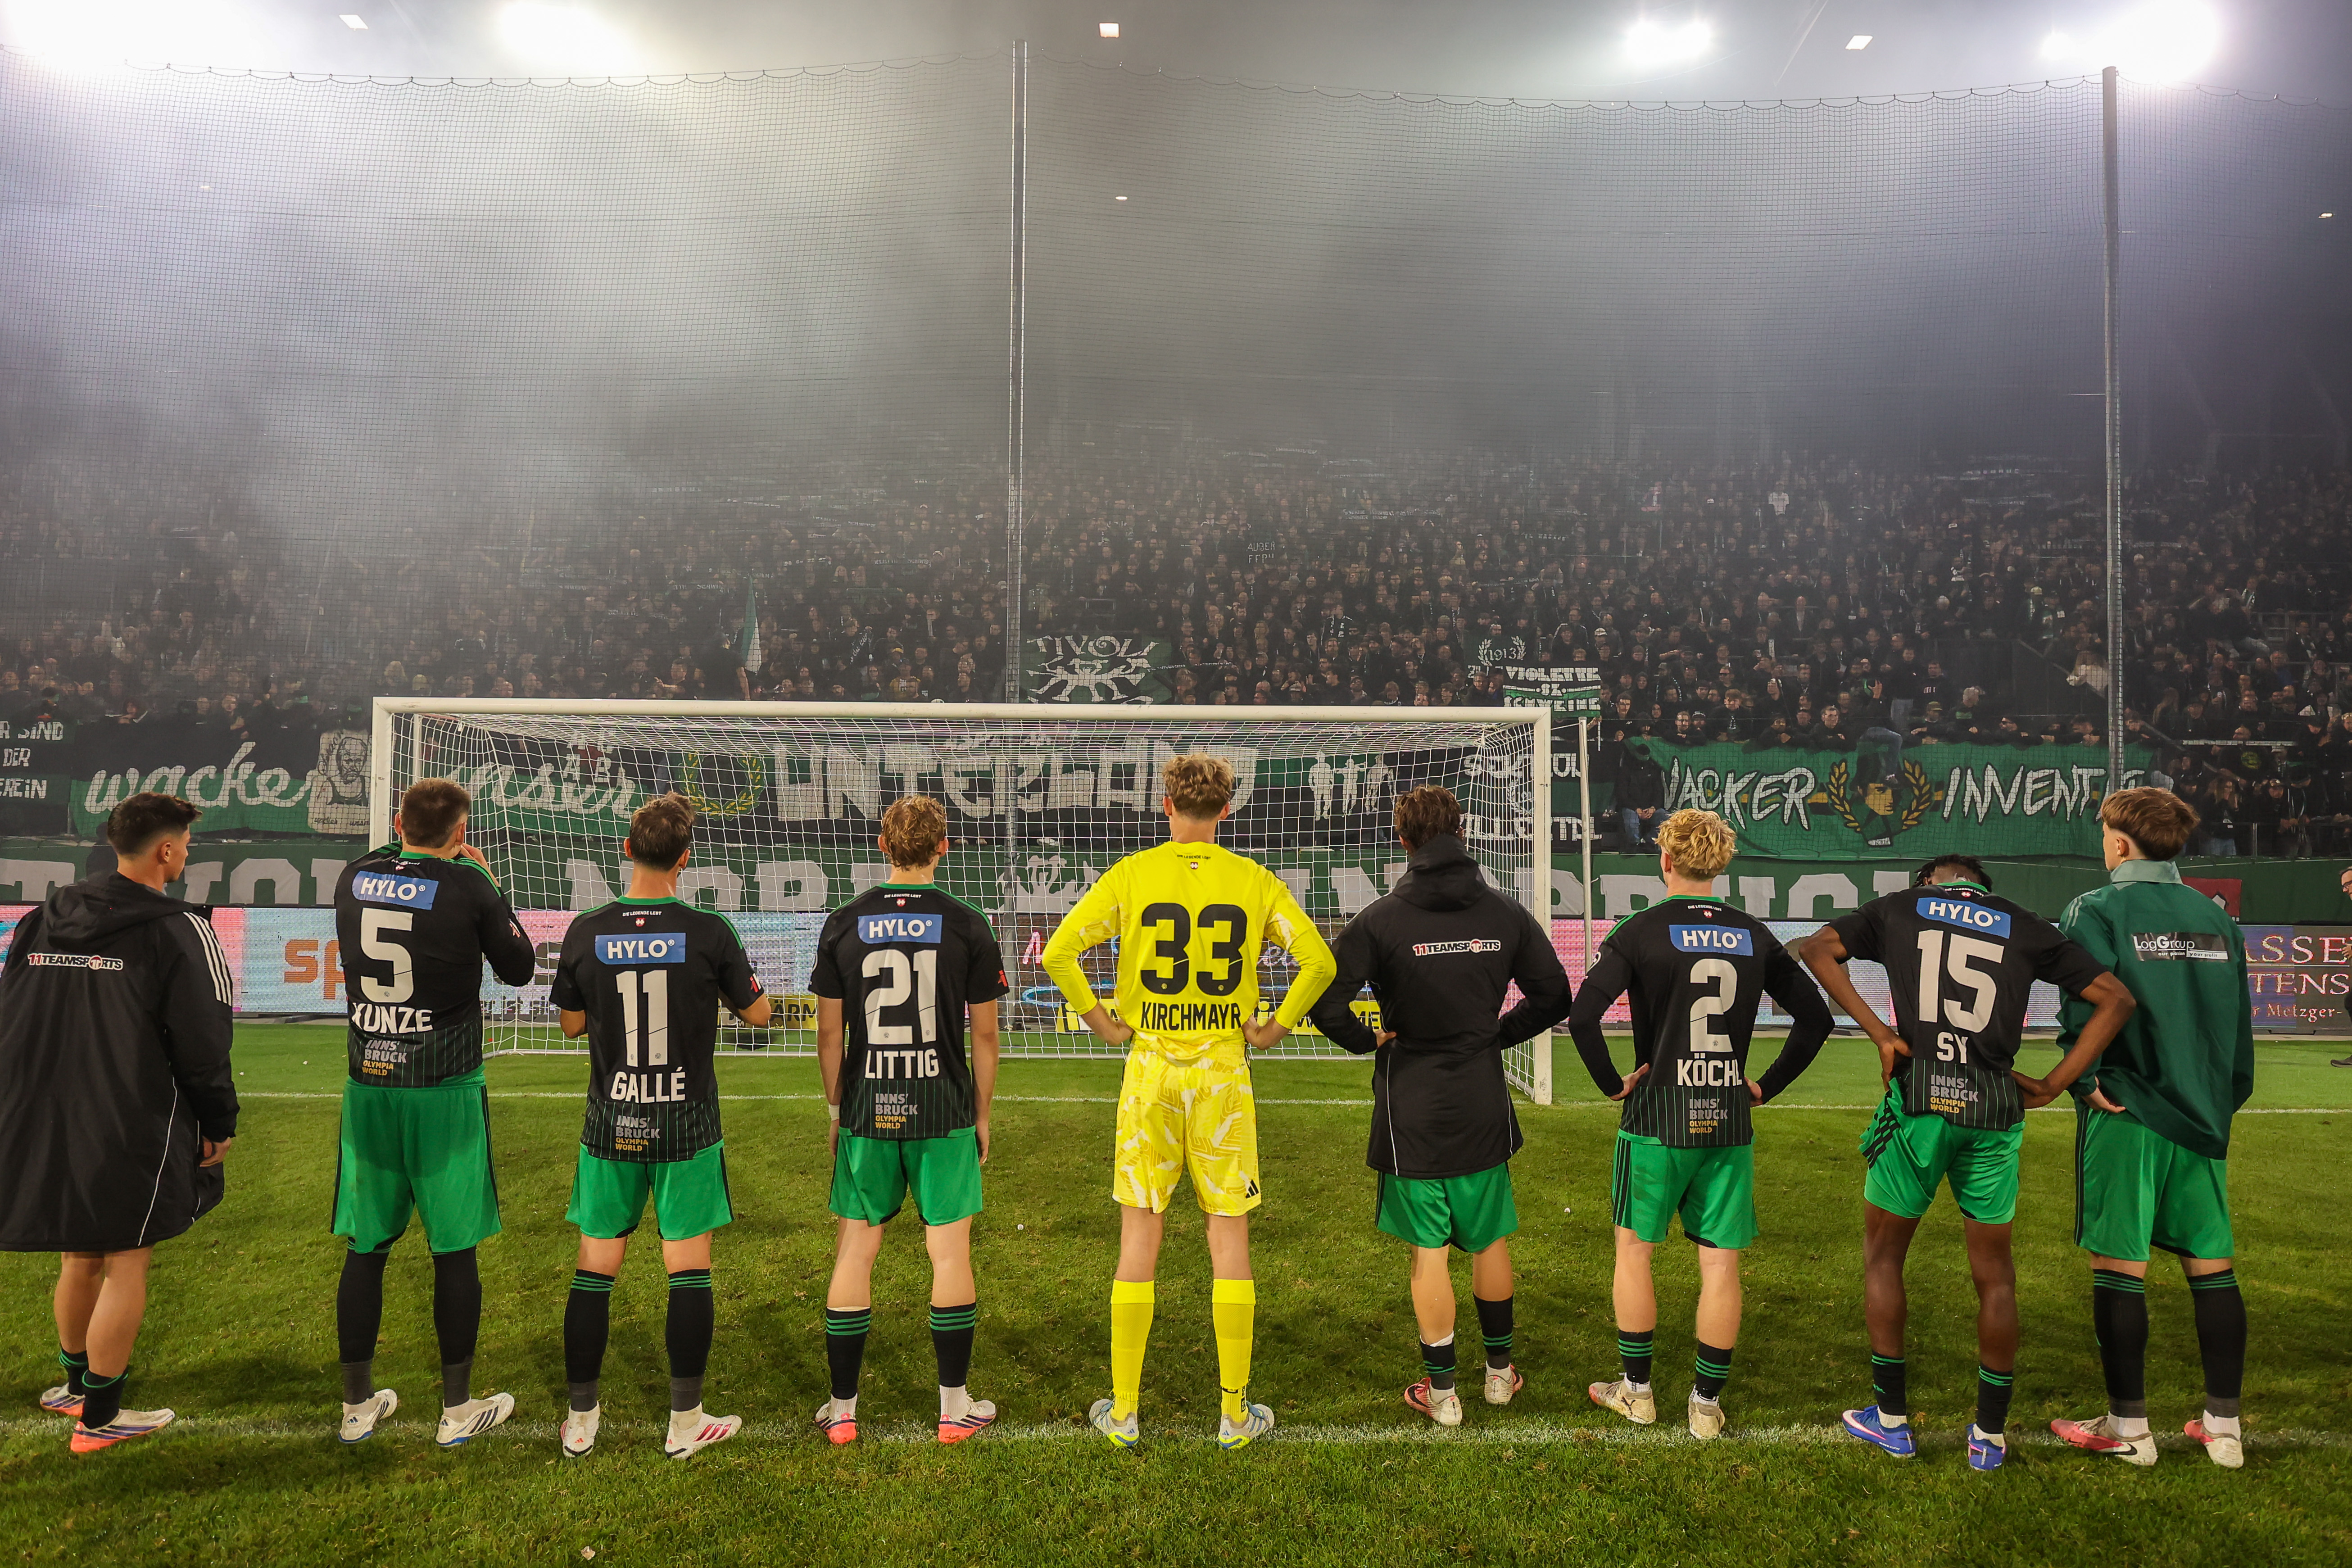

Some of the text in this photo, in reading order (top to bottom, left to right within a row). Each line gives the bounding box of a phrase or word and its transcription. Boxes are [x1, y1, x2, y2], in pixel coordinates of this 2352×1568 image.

[1488, 647, 1518, 661] 1913
[1505, 666, 1601, 681] VIOLETTE
[3, 748, 31, 767] DER
[1141, 902, 1247, 996] 33
[2133, 936, 2195, 951] LogGroup
[361, 908, 414, 1002] 5
[1917, 929, 2005, 1033] 15
[862, 949, 937, 1045] 21
[1690, 958, 1737, 1052] 2
[616, 970, 667, 1067] 11
[1141, 1001, 1241, 1031] KIRCHMAYR
[364, 1050, 407, 1063] BRUCK
[1937, 1032, 1968, 1064] SY
[362, 1067, 387, 1076] WORLD
[363, 1060, 394, 1070] OLYMPIA
[865, 1048, 939, 1079] LITTIG
[1677, 1053, 1742, 1087] KÖCHL
[610, 1067, 686, 1104] GALLÉ
[1931, 1086, 1978, 1102] BRUCK
[875, 1104, 918, 1115] BRUCK
[1930, 1097, 1966, 1108] OLYMPIA
[1930, 1103, 1960, 1114] WORLD
[1689, 1109, 1728, 1119] BRUCK
[616, 1127, 660, 1139] BRUCK
